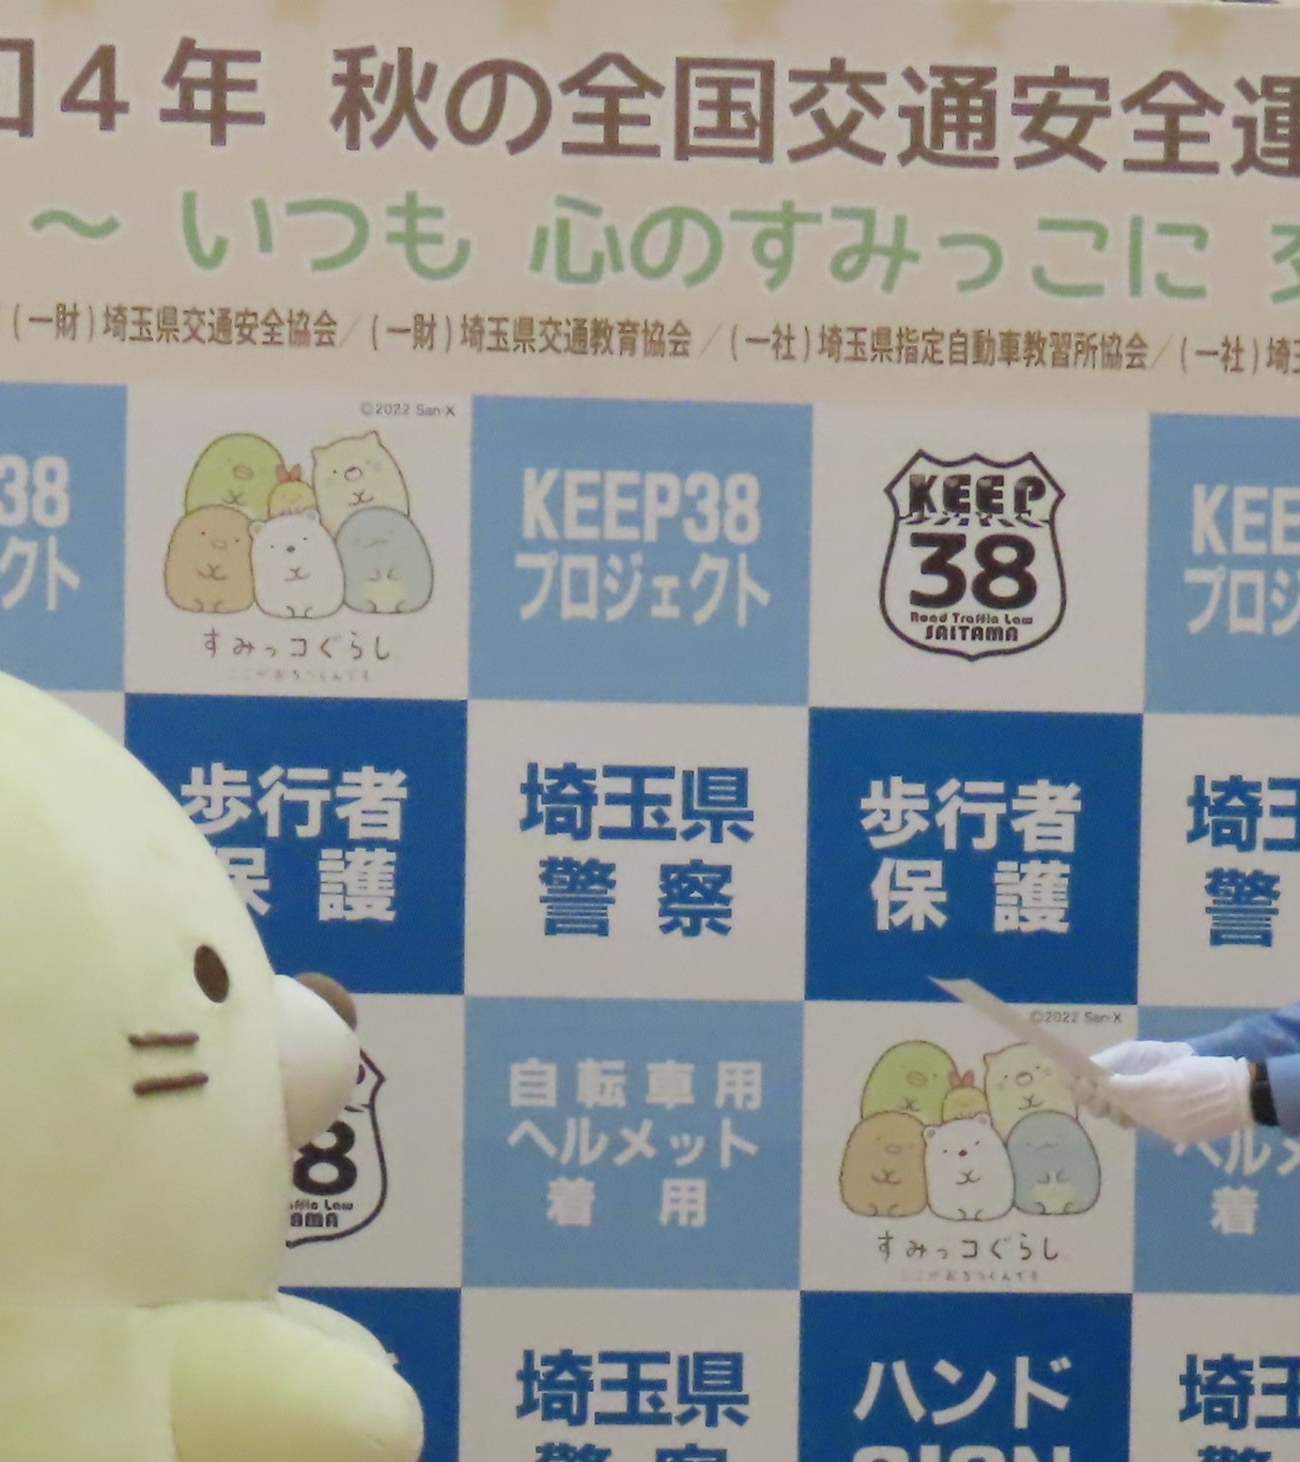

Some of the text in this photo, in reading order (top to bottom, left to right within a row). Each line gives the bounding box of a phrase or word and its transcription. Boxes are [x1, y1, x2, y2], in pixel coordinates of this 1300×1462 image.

[180, 189, 472, 282] いつも
[529, 195, 1208, 303] 心のすみっこに
[522, 466, 762, 544] KEEP38
[908, 473, 1046, 516] KEEP
[515, 549, 770, 628] プロジェクト
[908, 531, 1038, 610] 38
[204, 627, 390, 660] すみっコぐらし
[925, 625, 1019, 642] SAITAMA
[181, 763, 408, 841] 歩行者
[519, 761, 755, 844] 埼玉県
[860, 775, 1082, 855] 歩行者
[538, 856, 734, 937] 警察
[869, 857, 1071, 934] 保護
[509, 1058, 763, 1110] 自転車用
[293, 1119, 358, 1196] 8
[508, 1117, 758, 1168] ヘルメット
[877, 1230, 1059, 1262] すみっコぐらし
[516, 1349, 750, 1428] 埼玉県
[852, 1355, 1072, 1430] ハンド
